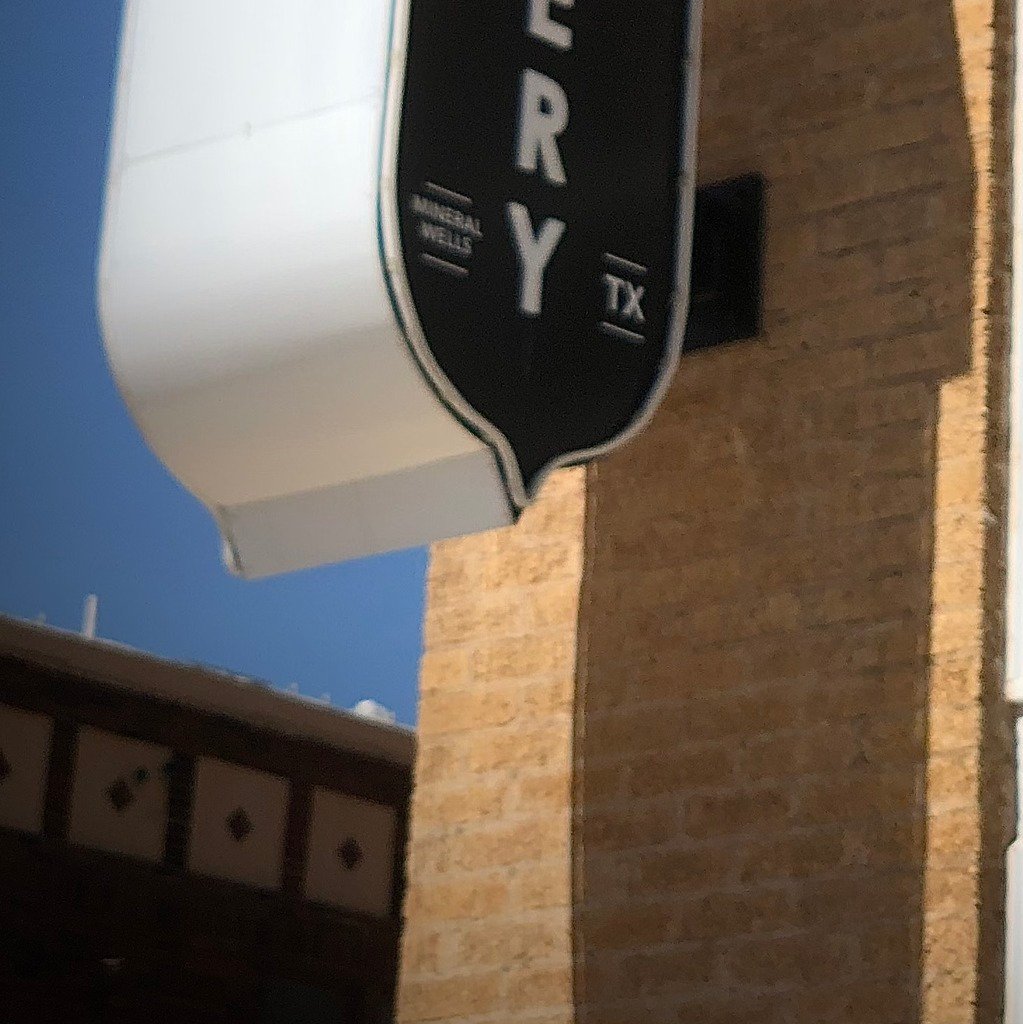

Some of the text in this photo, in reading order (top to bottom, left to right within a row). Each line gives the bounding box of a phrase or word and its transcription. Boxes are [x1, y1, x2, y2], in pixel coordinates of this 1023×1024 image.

[411, 193, 483, 237] MINERAL
[420, 221, 472, 255] WELLS
[604, 273, 646, 324] TX
